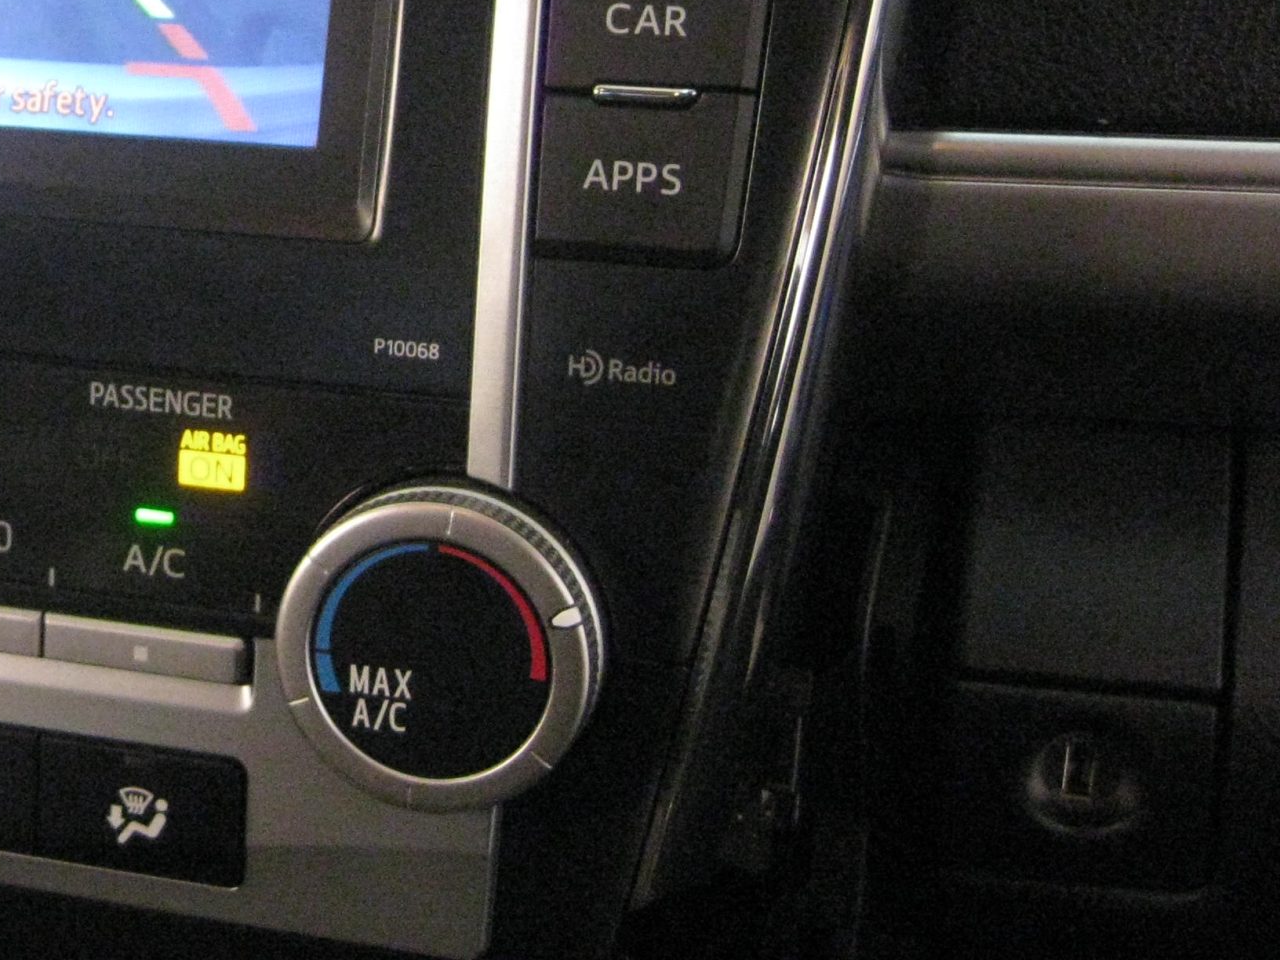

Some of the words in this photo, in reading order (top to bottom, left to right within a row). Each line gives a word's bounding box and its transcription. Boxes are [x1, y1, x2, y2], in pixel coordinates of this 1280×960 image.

[605, 2, 688, 38] CAR
[10, 79, 115, 125] safety.
[583, 159, 683, 196] APPS
[373, 338, 441, 361] P10068
[607, 358, 677, 386] Radio
[89, 381, 234, 420] PASSENGER
[180, 428, 210, 452] AIR
[211, 431, 247, 456] BAG
[190, 455, 234, 485] ON
[123, 544, 187, 580] A/C
[349, 663, 413, 700] MAX
[351, 701, 407, 733] A/C
